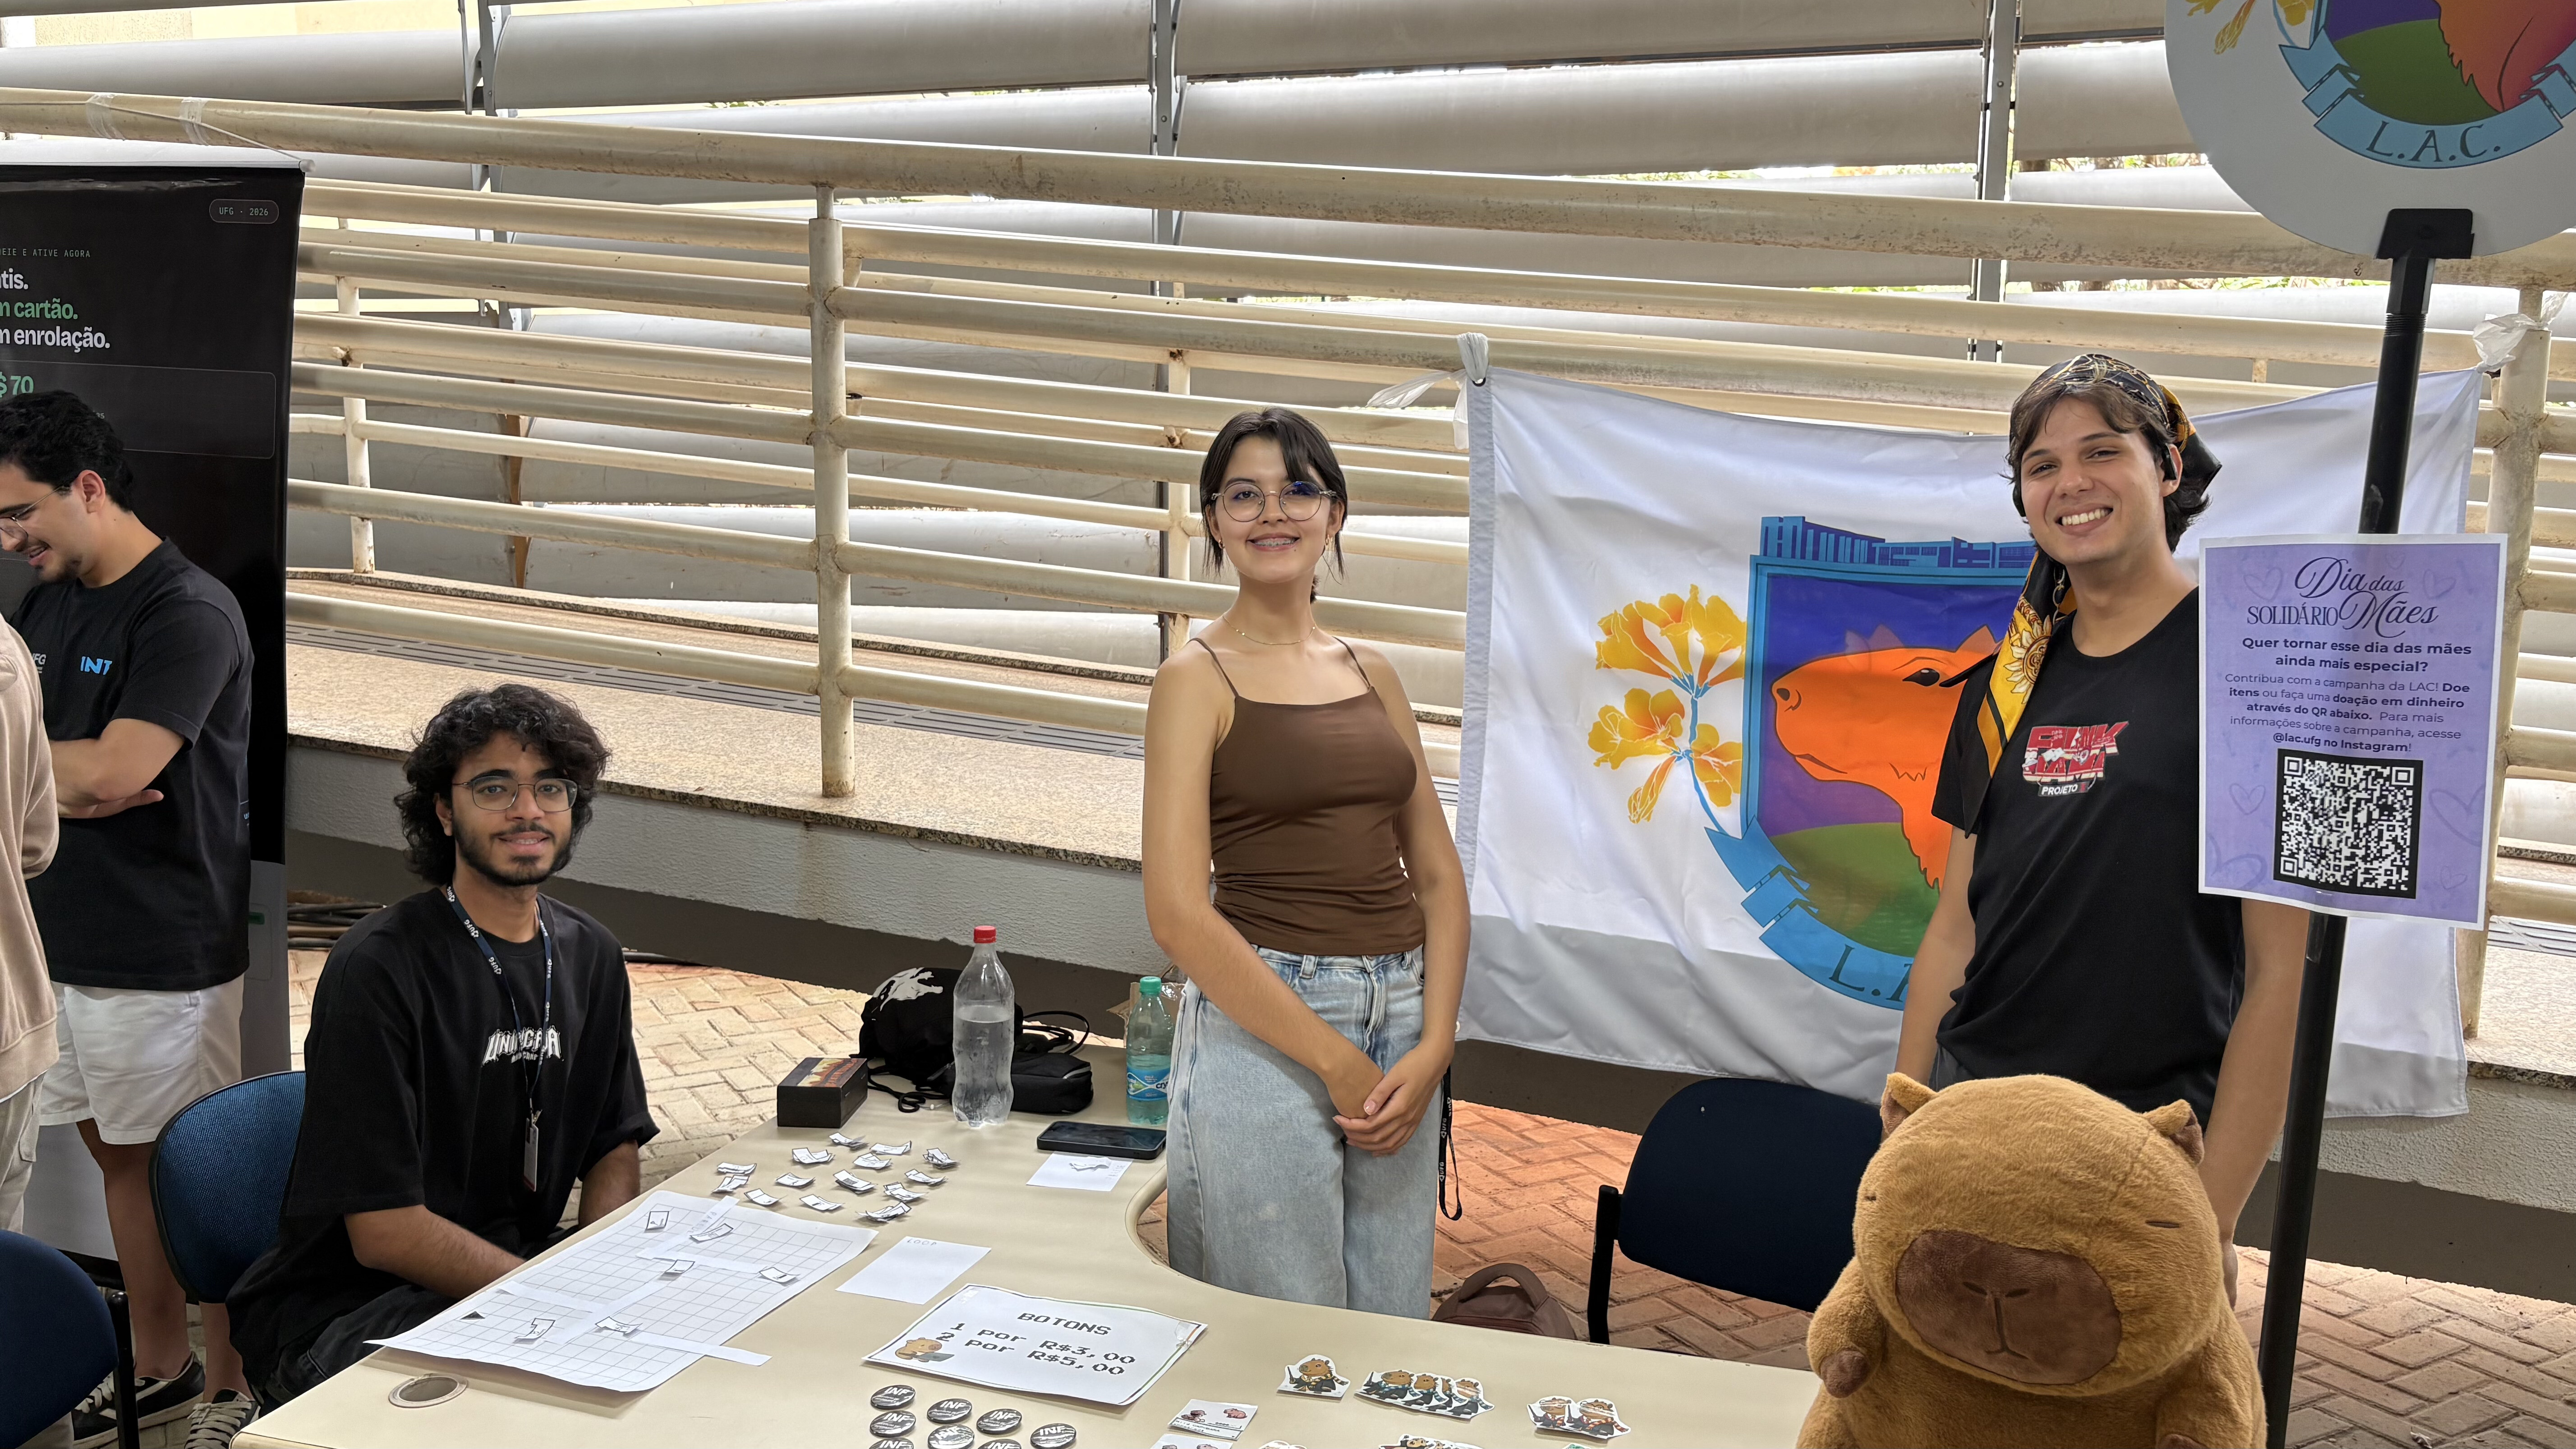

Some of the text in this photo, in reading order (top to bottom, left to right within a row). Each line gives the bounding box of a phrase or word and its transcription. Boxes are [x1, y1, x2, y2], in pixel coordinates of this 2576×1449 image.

[2366, 120, 2501, 162] L.A.C.
[0, 268, 28, 289] tis.
[14, 298, 78, 319] cartão.
[14, 326, 110, 353] enrolação.
[10, 376, 34, 395] 70
[2295, 557, 2404, 598] Dia das
[2247, 591, 2439, 638] SOLIDÁRIO Mães
[2243, 638, 2471, 654] Quer tornar esse dia das mães
[2276, 655, 2428, 673] ainda mais especial?
[2225, 674, 2283, 683] Contribua
[2323, 679, 2385, 690] campanha
[2389, 681, 2405, 690] da
[2409, 682, 2438, 691] LAC!
[2443, 683, 2470, 692] Doe
[2229, 688, 2259, 696] itens
[2281, 690, 2304, 700] faça
[2307, 693, 2330, 701] uma
[2333, 694, 2377, 706] doação
[2407, 697, 2464, 708] dinheiro
[2247, 704, 2444, 722] através do QR abaixo. Para mais
[2231, 716, 2301, 728] informações
[2304, 722, 2332, 731] sobre
[2343, 727, 2414, 738] campanha,
[2418, 730, 2461, 739] acesse
[2273, 733, 2321, 746] @lac.ufg
[2341, 740, 2411, 752] Instagram!
[2041, 783, 2078, 795] PROJETO
[464, 919, 475, 933] UFG
[488, 957, 499, 971] UFG
[1017, 1313, 1112, 1335] BOTONS
[950, 1323, 1136, 1364] 1 por R$3,00
[935, 1332, 1125, 1375] 2 por R$5,00
[884, 1387, 911, 1395] INF
[940, 1401, 966, 1409] INF
[883, 1412, 911, 1422] INF
[989, 1411, 1016, 1420] INF
[1039, 1426, 1065, 1435] INF
[879, 1440, 906, 1449] INF
